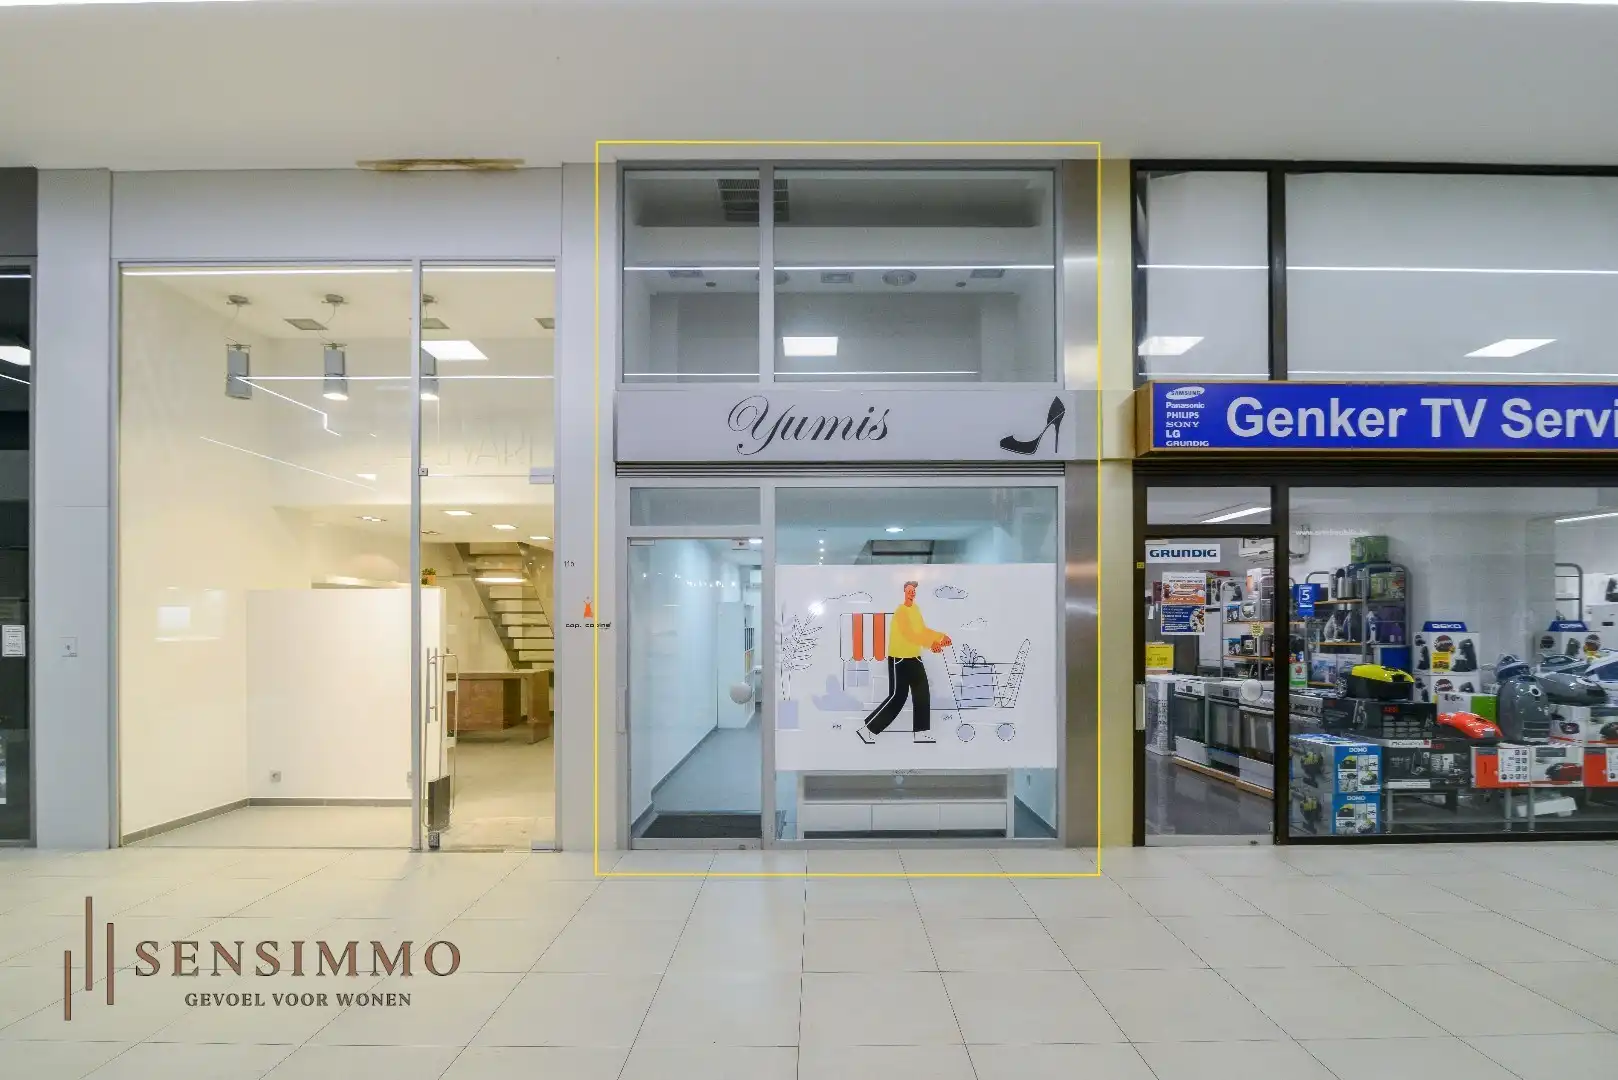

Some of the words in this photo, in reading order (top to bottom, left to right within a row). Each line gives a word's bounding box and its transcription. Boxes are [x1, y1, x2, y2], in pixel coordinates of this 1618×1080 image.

[1165, 401, 1205, 409] Panasonic
[1166, 411, 1200, 419] PHILIPS
[1226, 396, 1407, 438] Genker
[1420, 398, 1487, 438] TV
[727, 395, 890, 456] Yumis
[1165, 429, 1181, 439] LG
[1149, 549, 1217, 558] GRUNDIG
